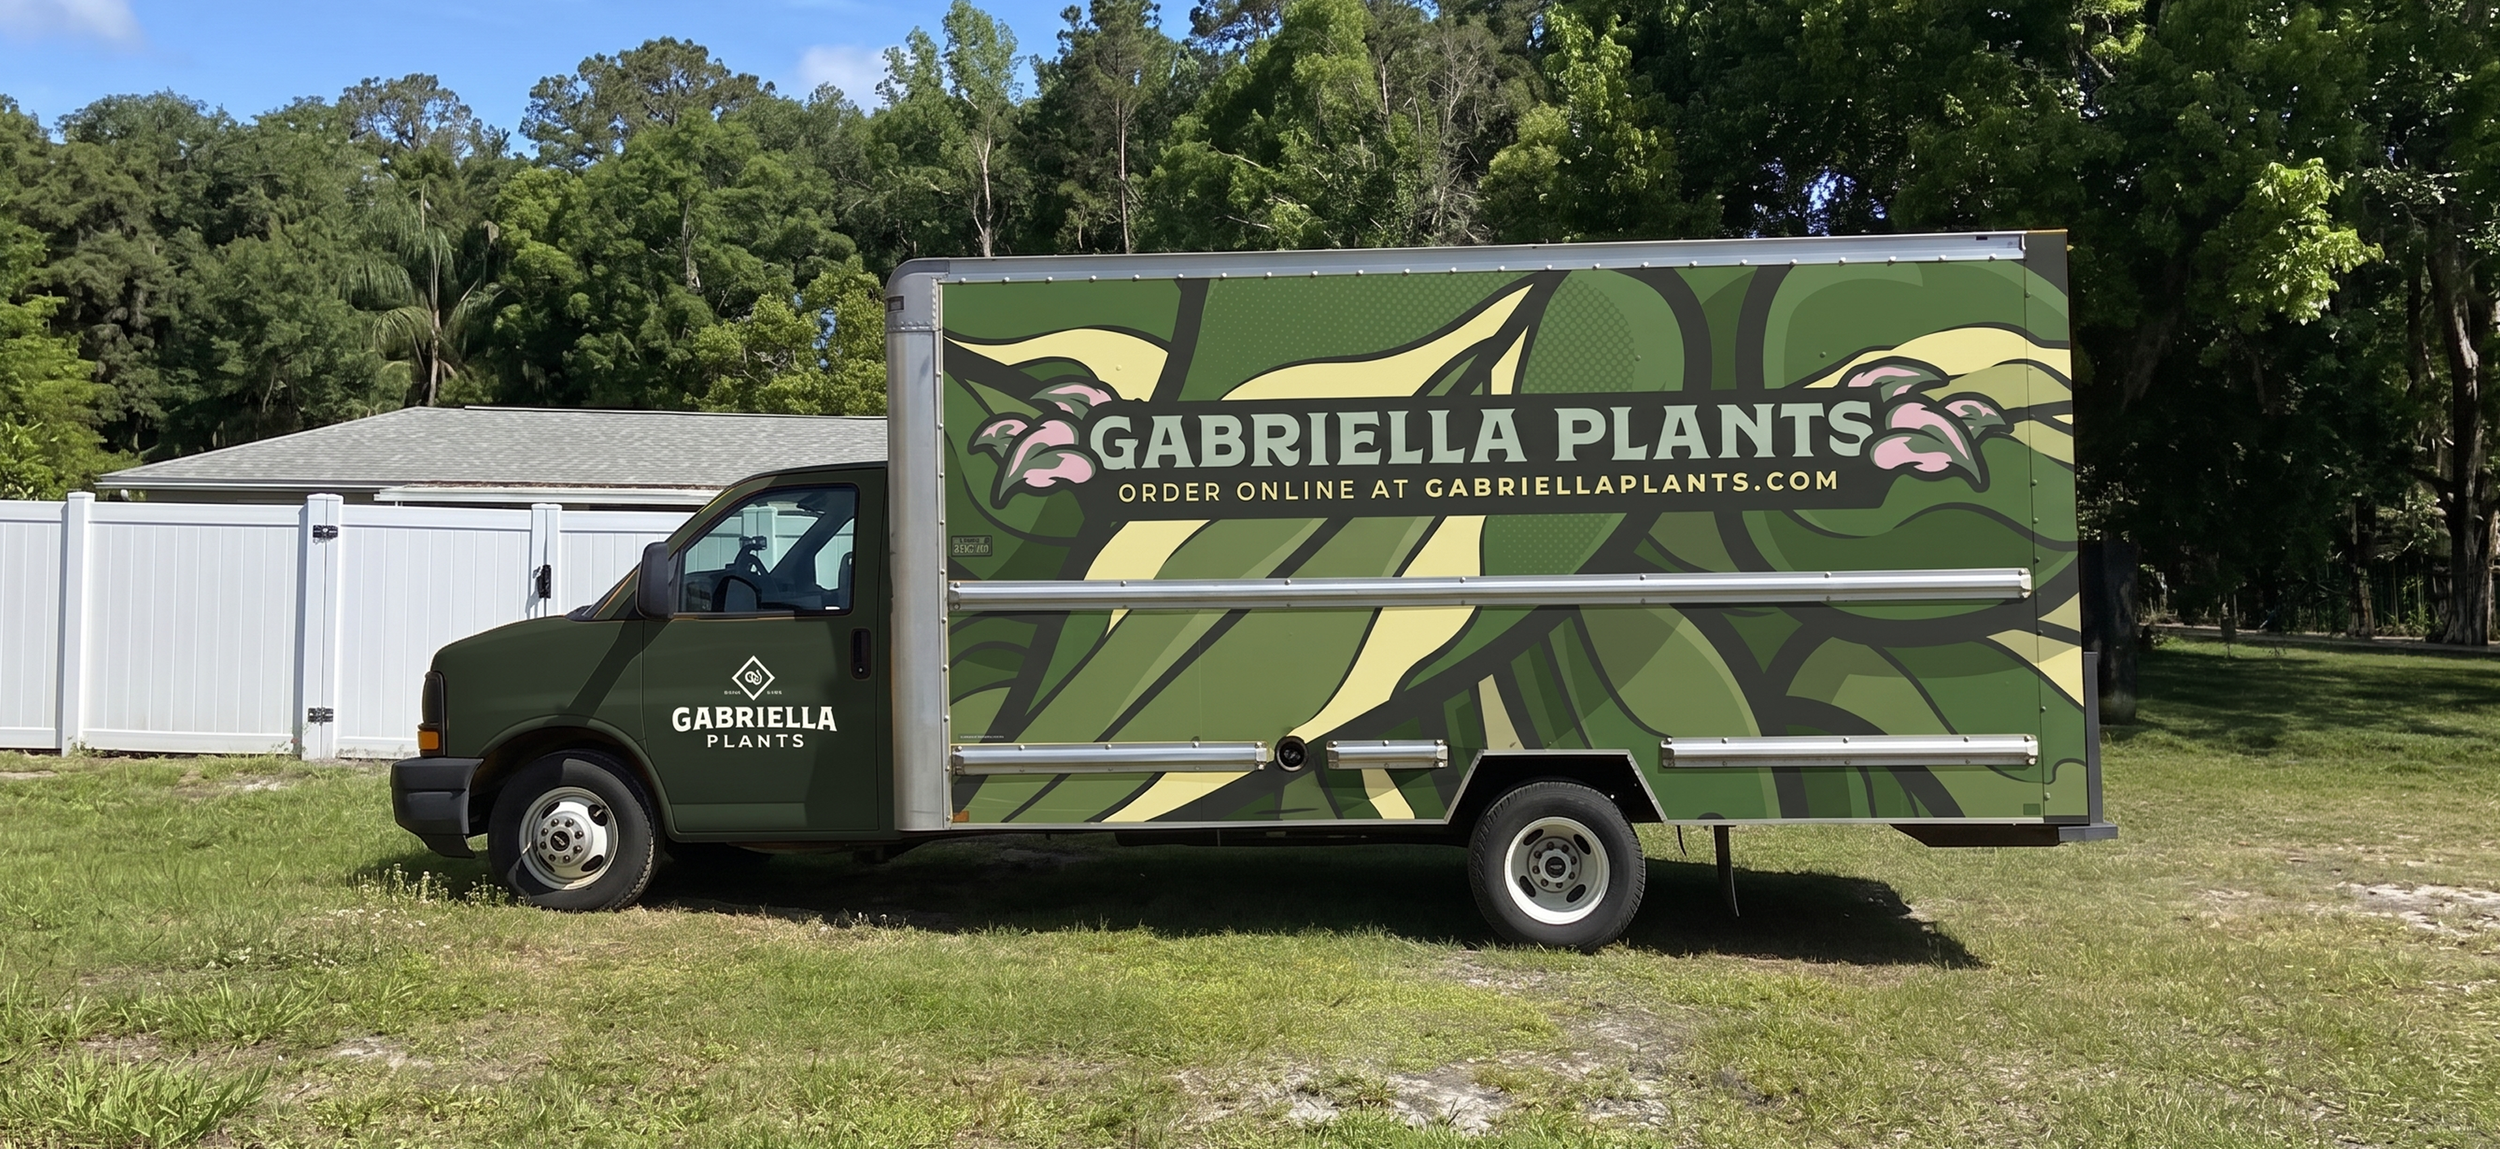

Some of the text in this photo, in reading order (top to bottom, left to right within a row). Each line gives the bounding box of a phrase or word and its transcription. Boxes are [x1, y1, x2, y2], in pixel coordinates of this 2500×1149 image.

[1089, 400, 1874, 471] GABRIELLA PLANTS
[1118, 470, 1838, 504] ORDER ONLINE AT GABRIELLAPLANTS.COM
[671, 705, 838, 733] GABRIELLA
[706, 733, 805, 749] PLANTS
